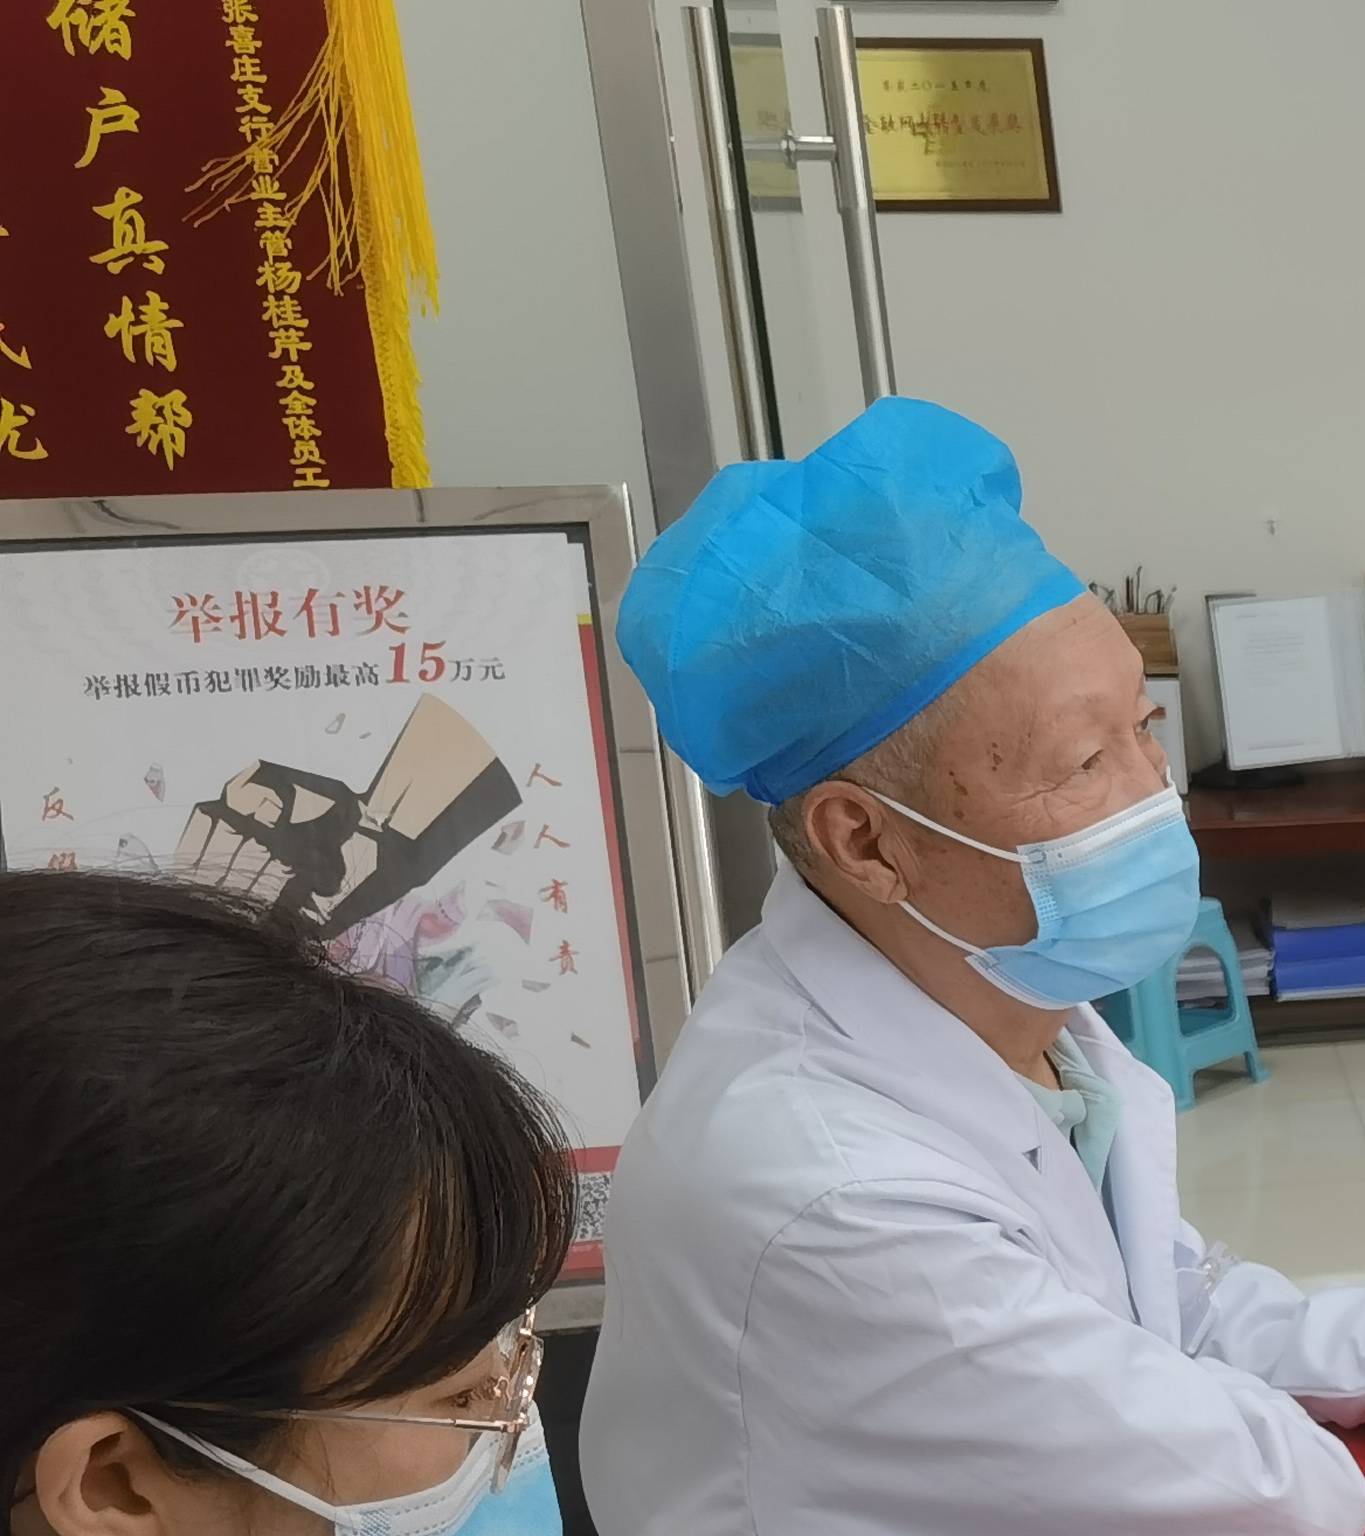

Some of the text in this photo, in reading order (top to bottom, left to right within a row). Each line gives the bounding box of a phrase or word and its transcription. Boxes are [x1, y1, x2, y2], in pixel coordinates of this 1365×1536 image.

[169, 585, 411, 645] 举报有奖
[83, 640, 506, 701] 举报假币犯罪奖励最高15万元
[525, 762, 580, 976] 人人有责
